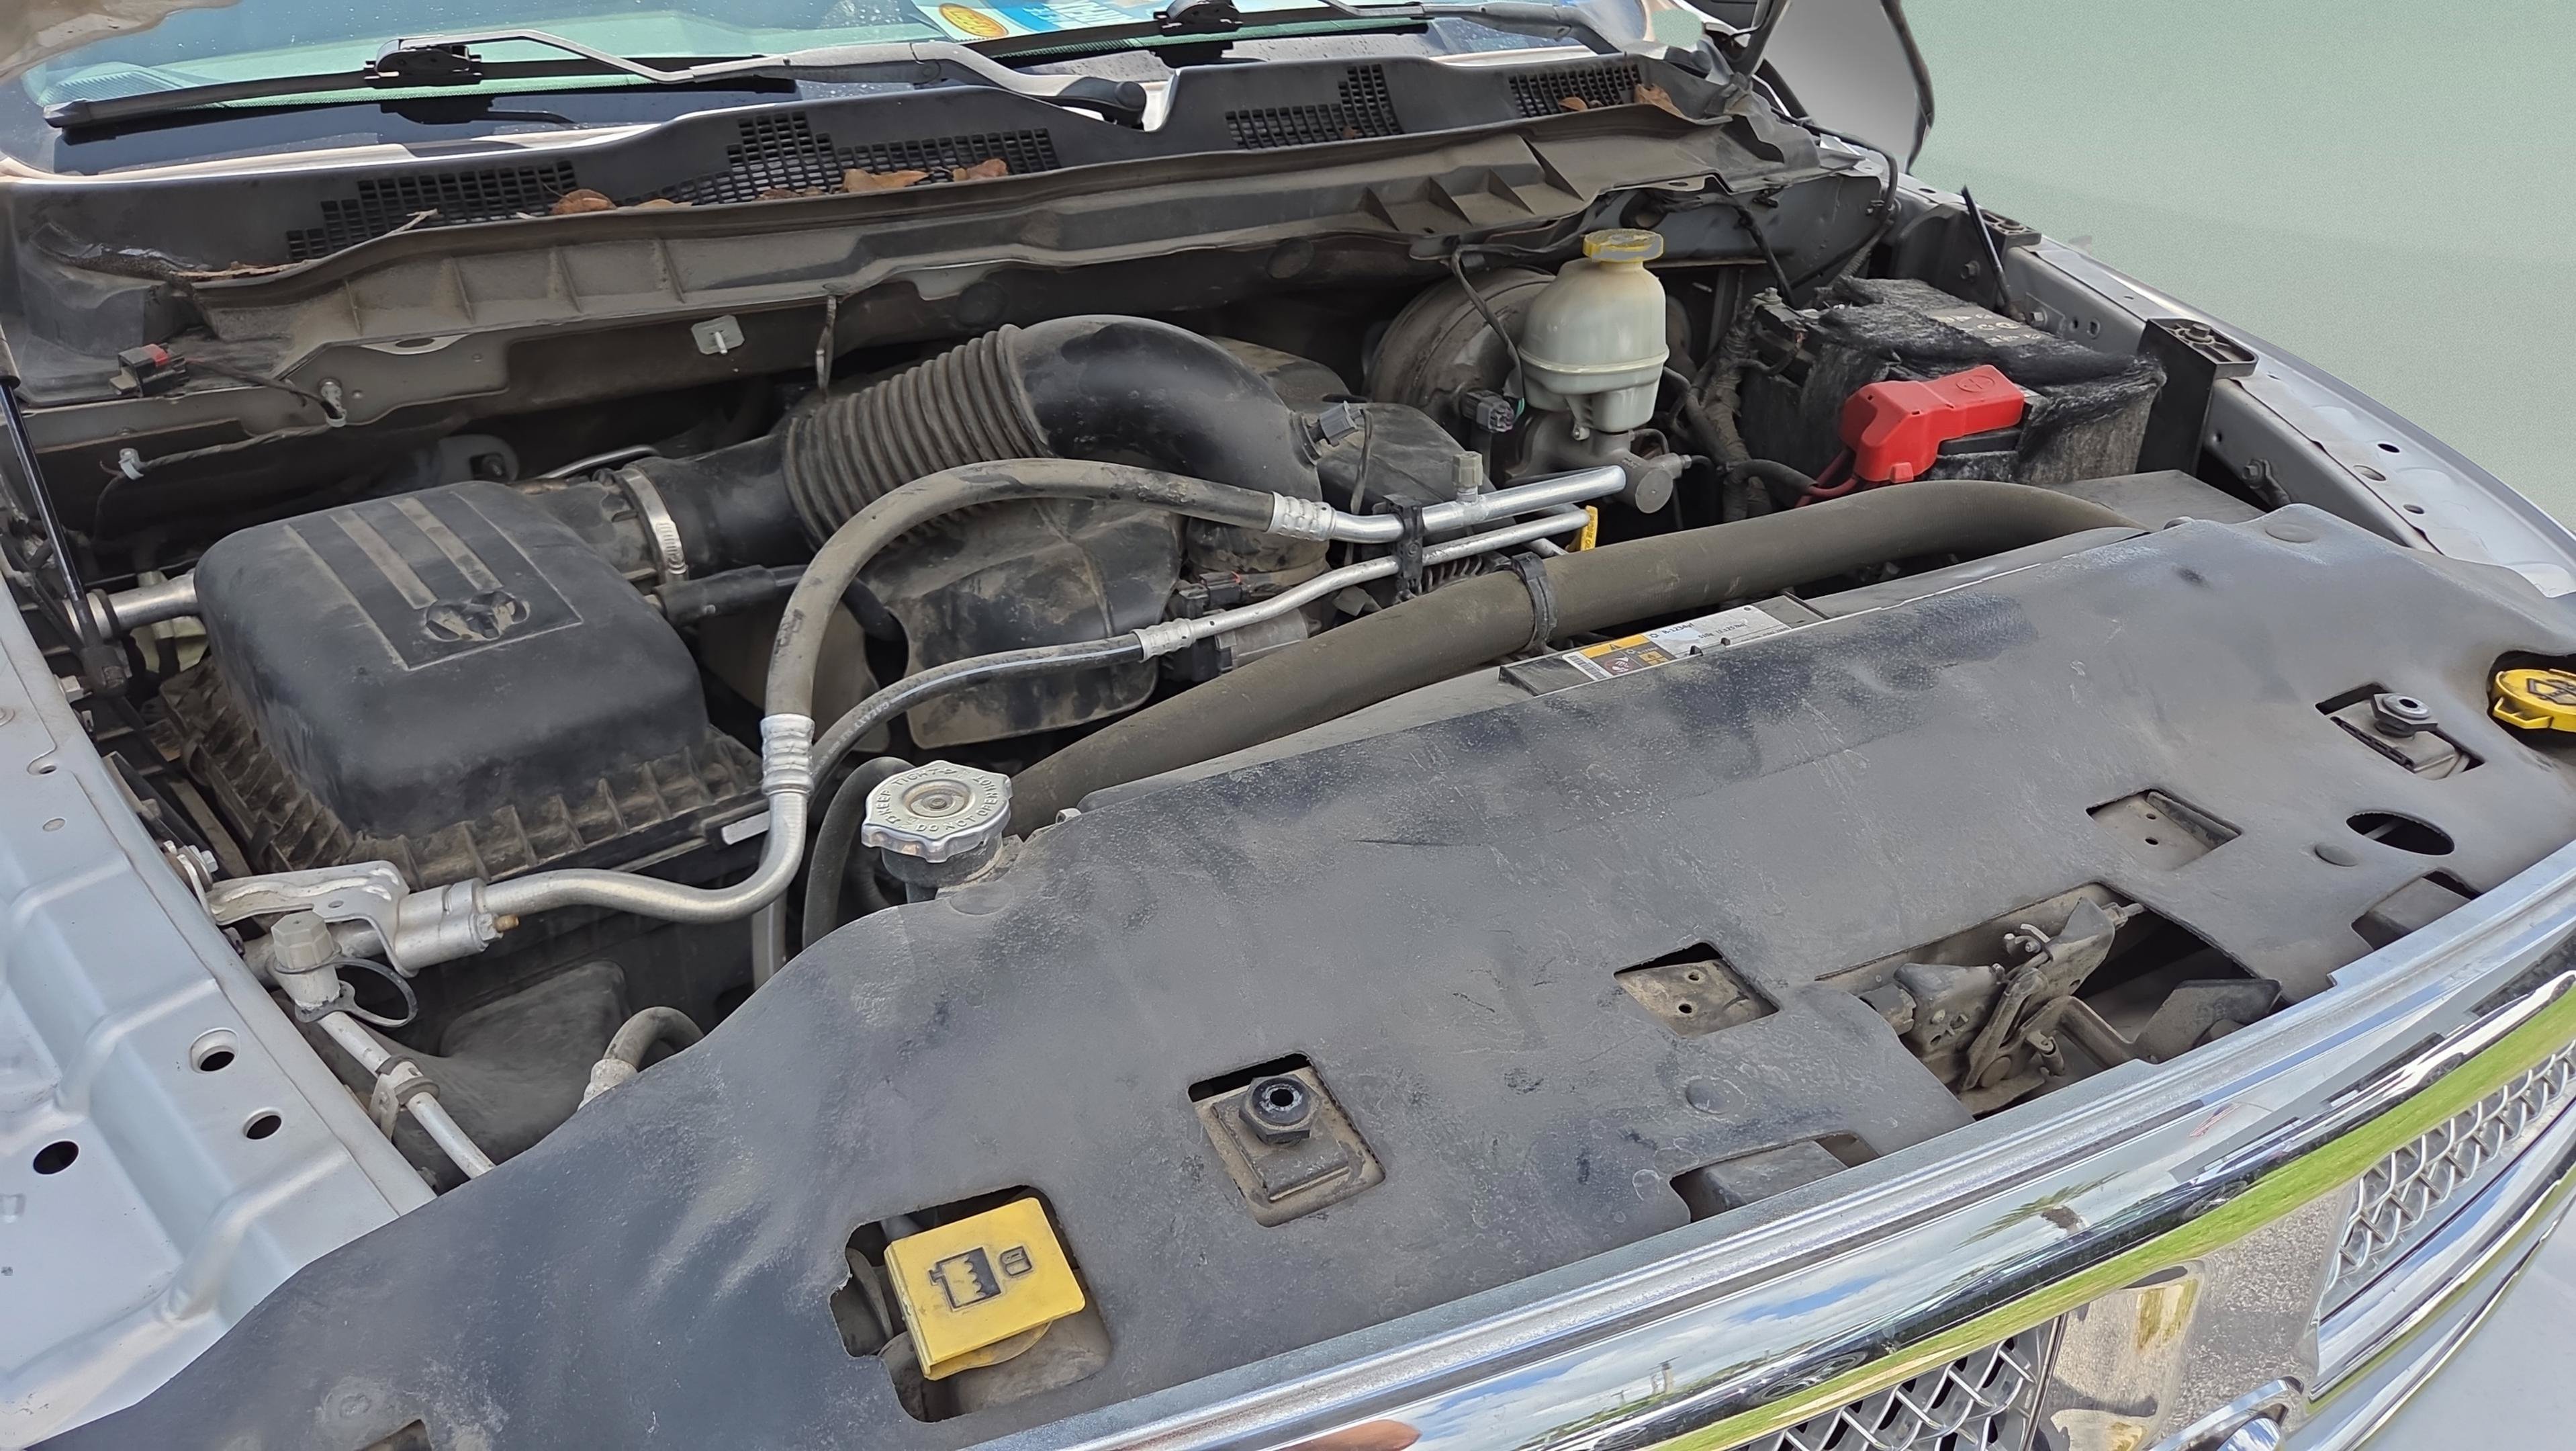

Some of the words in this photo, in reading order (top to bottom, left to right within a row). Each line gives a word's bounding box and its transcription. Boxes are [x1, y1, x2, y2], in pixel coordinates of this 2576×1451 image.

[876, 789, 892, 816] KEEP
[892, 768, 941, 786] TIGHT
[972, 775, 997, 792] HOT
[978, 793, 999, 817] OPEN
[916, 824, 939, 832] DO
[945, 816, 976, 831] NOT
